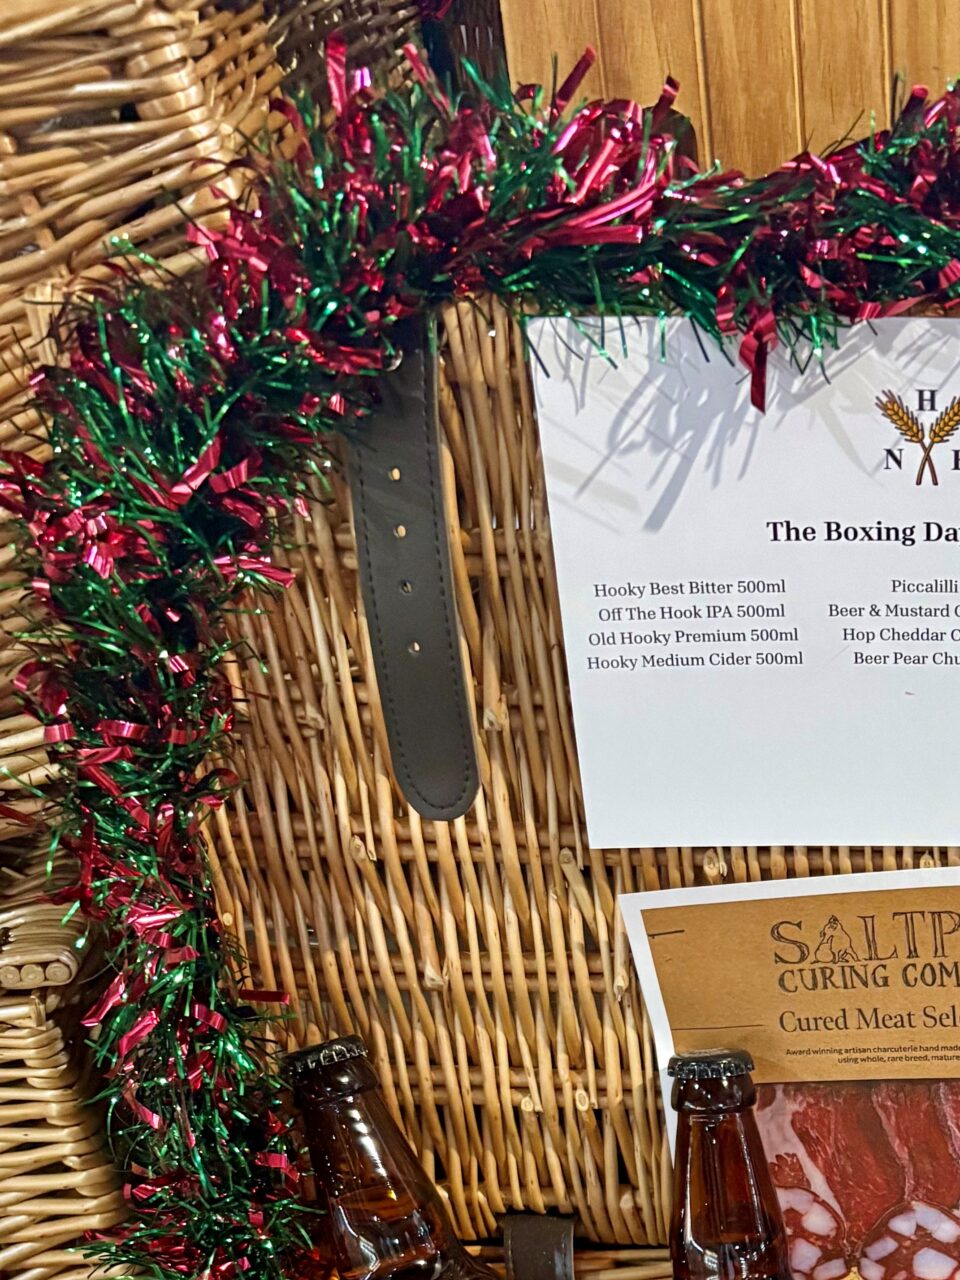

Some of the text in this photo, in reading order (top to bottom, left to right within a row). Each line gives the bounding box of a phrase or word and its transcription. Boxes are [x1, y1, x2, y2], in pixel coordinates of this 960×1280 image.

[916, 389, 938, 411] H
[883, 449, 904, 470] N
[766, 520, 817, 542] The
[824, 520, 916, 547] Boxing
[593, 579, 786, 598] Hooky Best Bitter 500ml
[891, 579, 959, 593] Piccalilli
[598, 604, 785, 622] Off The Hook IPA 500ml
[828, 604, 866, 618] Beer
[869, 604, 881, 618] &
[885, 604, 951, 618] Mustard
[588, 628, 799, 647] Old Hooky Premium 500ml
[842, 628, 876, 643] Hop
[879, 627, 947, 642] Cheddar
[587, 651, 803, 671] Hooky Medium Cider 500ml
[853, 651, 889, 666] Beer
[892, 651, 928, 666] Pear
[778, 963, 889, 993] CURING
[779, 1007, 850, 1033] Cured
[856, 1007, 917, 1031] Meat
[785, 1047, 812, 1057] Award
[812, 1047, 844, 1057] winning
[844, 1045, 872, 1054] artisan
[872, 1044, 918, 1054] charcuterie
[918, 1043, 939, 1053] hand
[931, 1054, 960, 1062] mature
